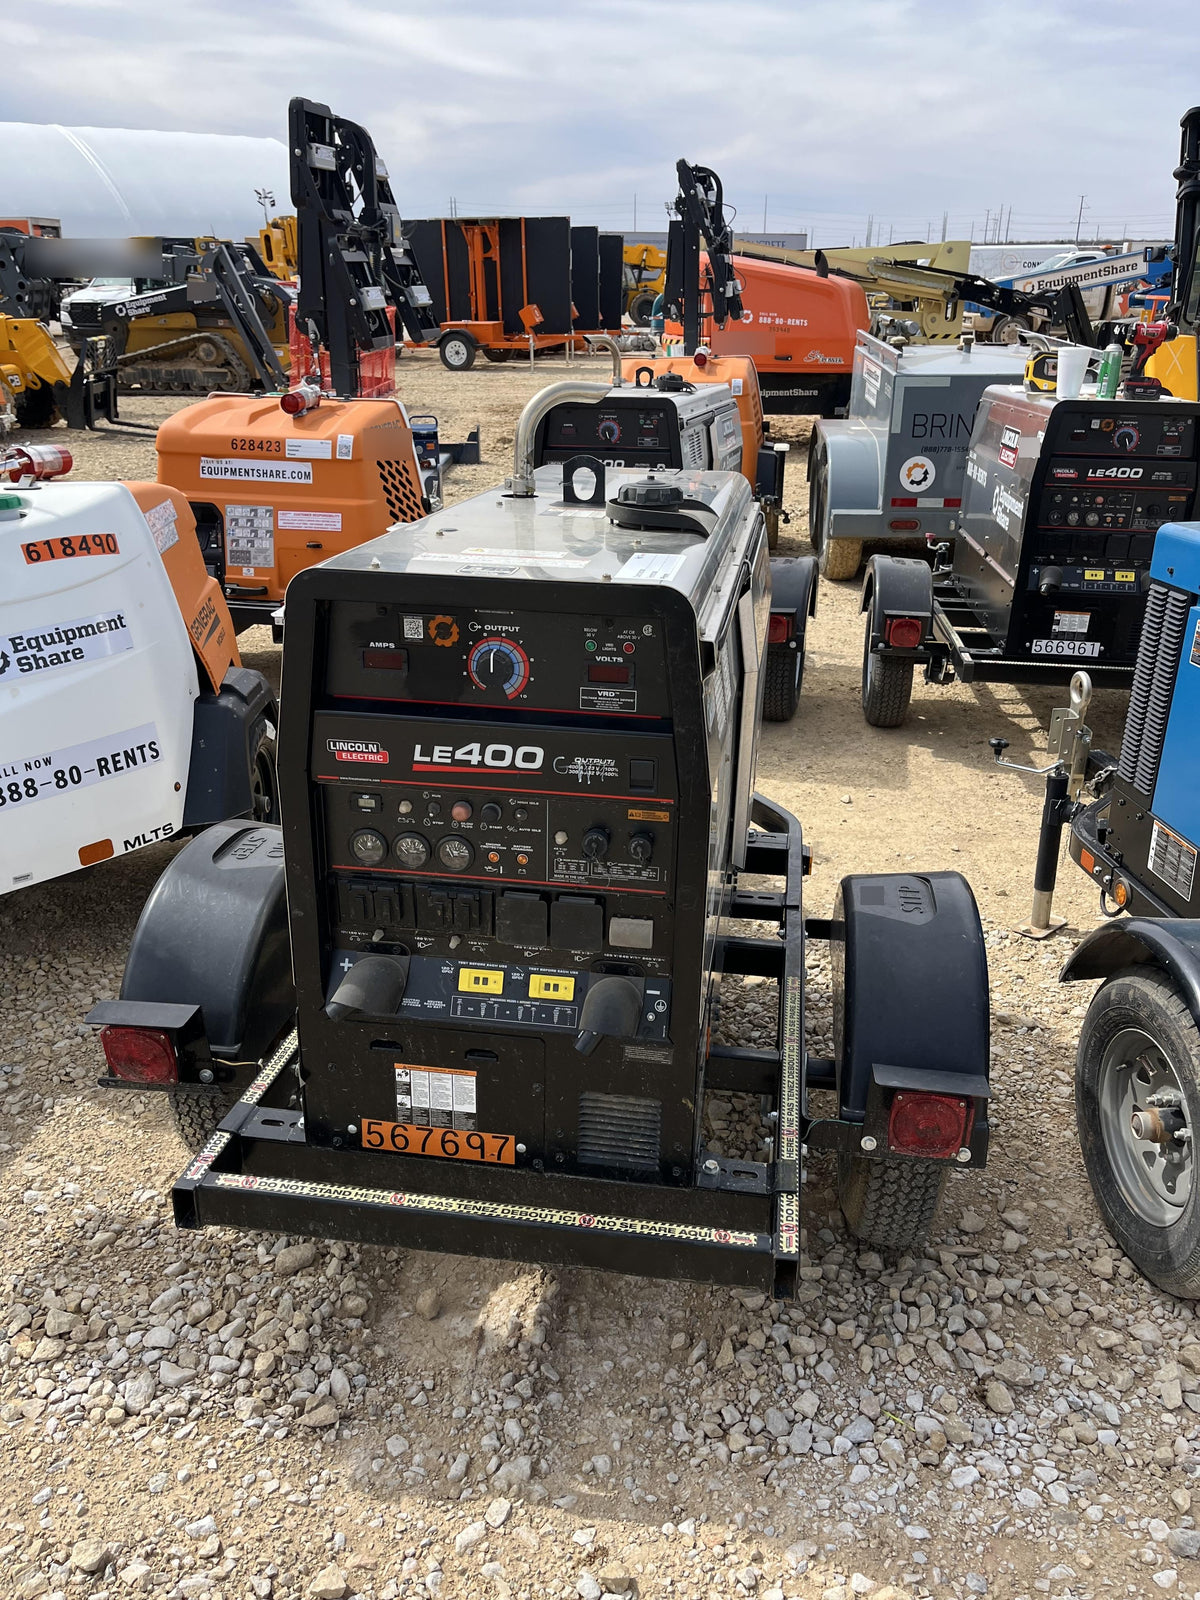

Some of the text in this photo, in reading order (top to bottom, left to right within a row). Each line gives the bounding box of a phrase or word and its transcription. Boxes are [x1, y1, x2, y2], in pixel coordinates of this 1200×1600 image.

[1037, 263, 1138, 290] EquipmentShare
[125, 294, 167, 308] Equipment
[128, 306, 152, 316] Share
[759, 317, 808, 326] 888-80-RENTS
[760, 388, 818, 397] uipmentShare
[231, 438, 281, 453] 628423
[201, 466, 311, 481] EQUIPMENTSHARE.COM
[1088, 468, 1143, 478] LE400
[25, 534, 117, 563] 618490
[190, 597, 216, 641] GENERAC
[9, 614, 127, 653] Equipment
[1034, 640, 1096, 656] 566961
[16, 647, 85, 673] Share
[330, 742, 377, 752] LINCOLN
[413, 742, 545, 770] LE400
[342, 752, 384, 762] ELECTRIC
[0, 756, 52, 779] LL NOW
[123, 822, 174, 852] MLTS
[789, 1028, 796, 1038] NO
[246, 1045, 291, 1103] DEBOUT ICI NO
[787, 1117, 794, 1128] NE
[366, 1121, 510, 1162] 567697
[258, 1180, 388, 1201] DO NOT STAND HERE
[428, 1200, 455, 1209] PAS
[456, 1203, 499, 1214] TENEZ
[501, 1208, 558, 1221] DEBOUT
[786, 1190, 794, 1222] DO NO
[596, 1219, 617, 1228] NO
[619, 1221, 636, 1230] SE
[640, 1224, 677, 1235] PARE
